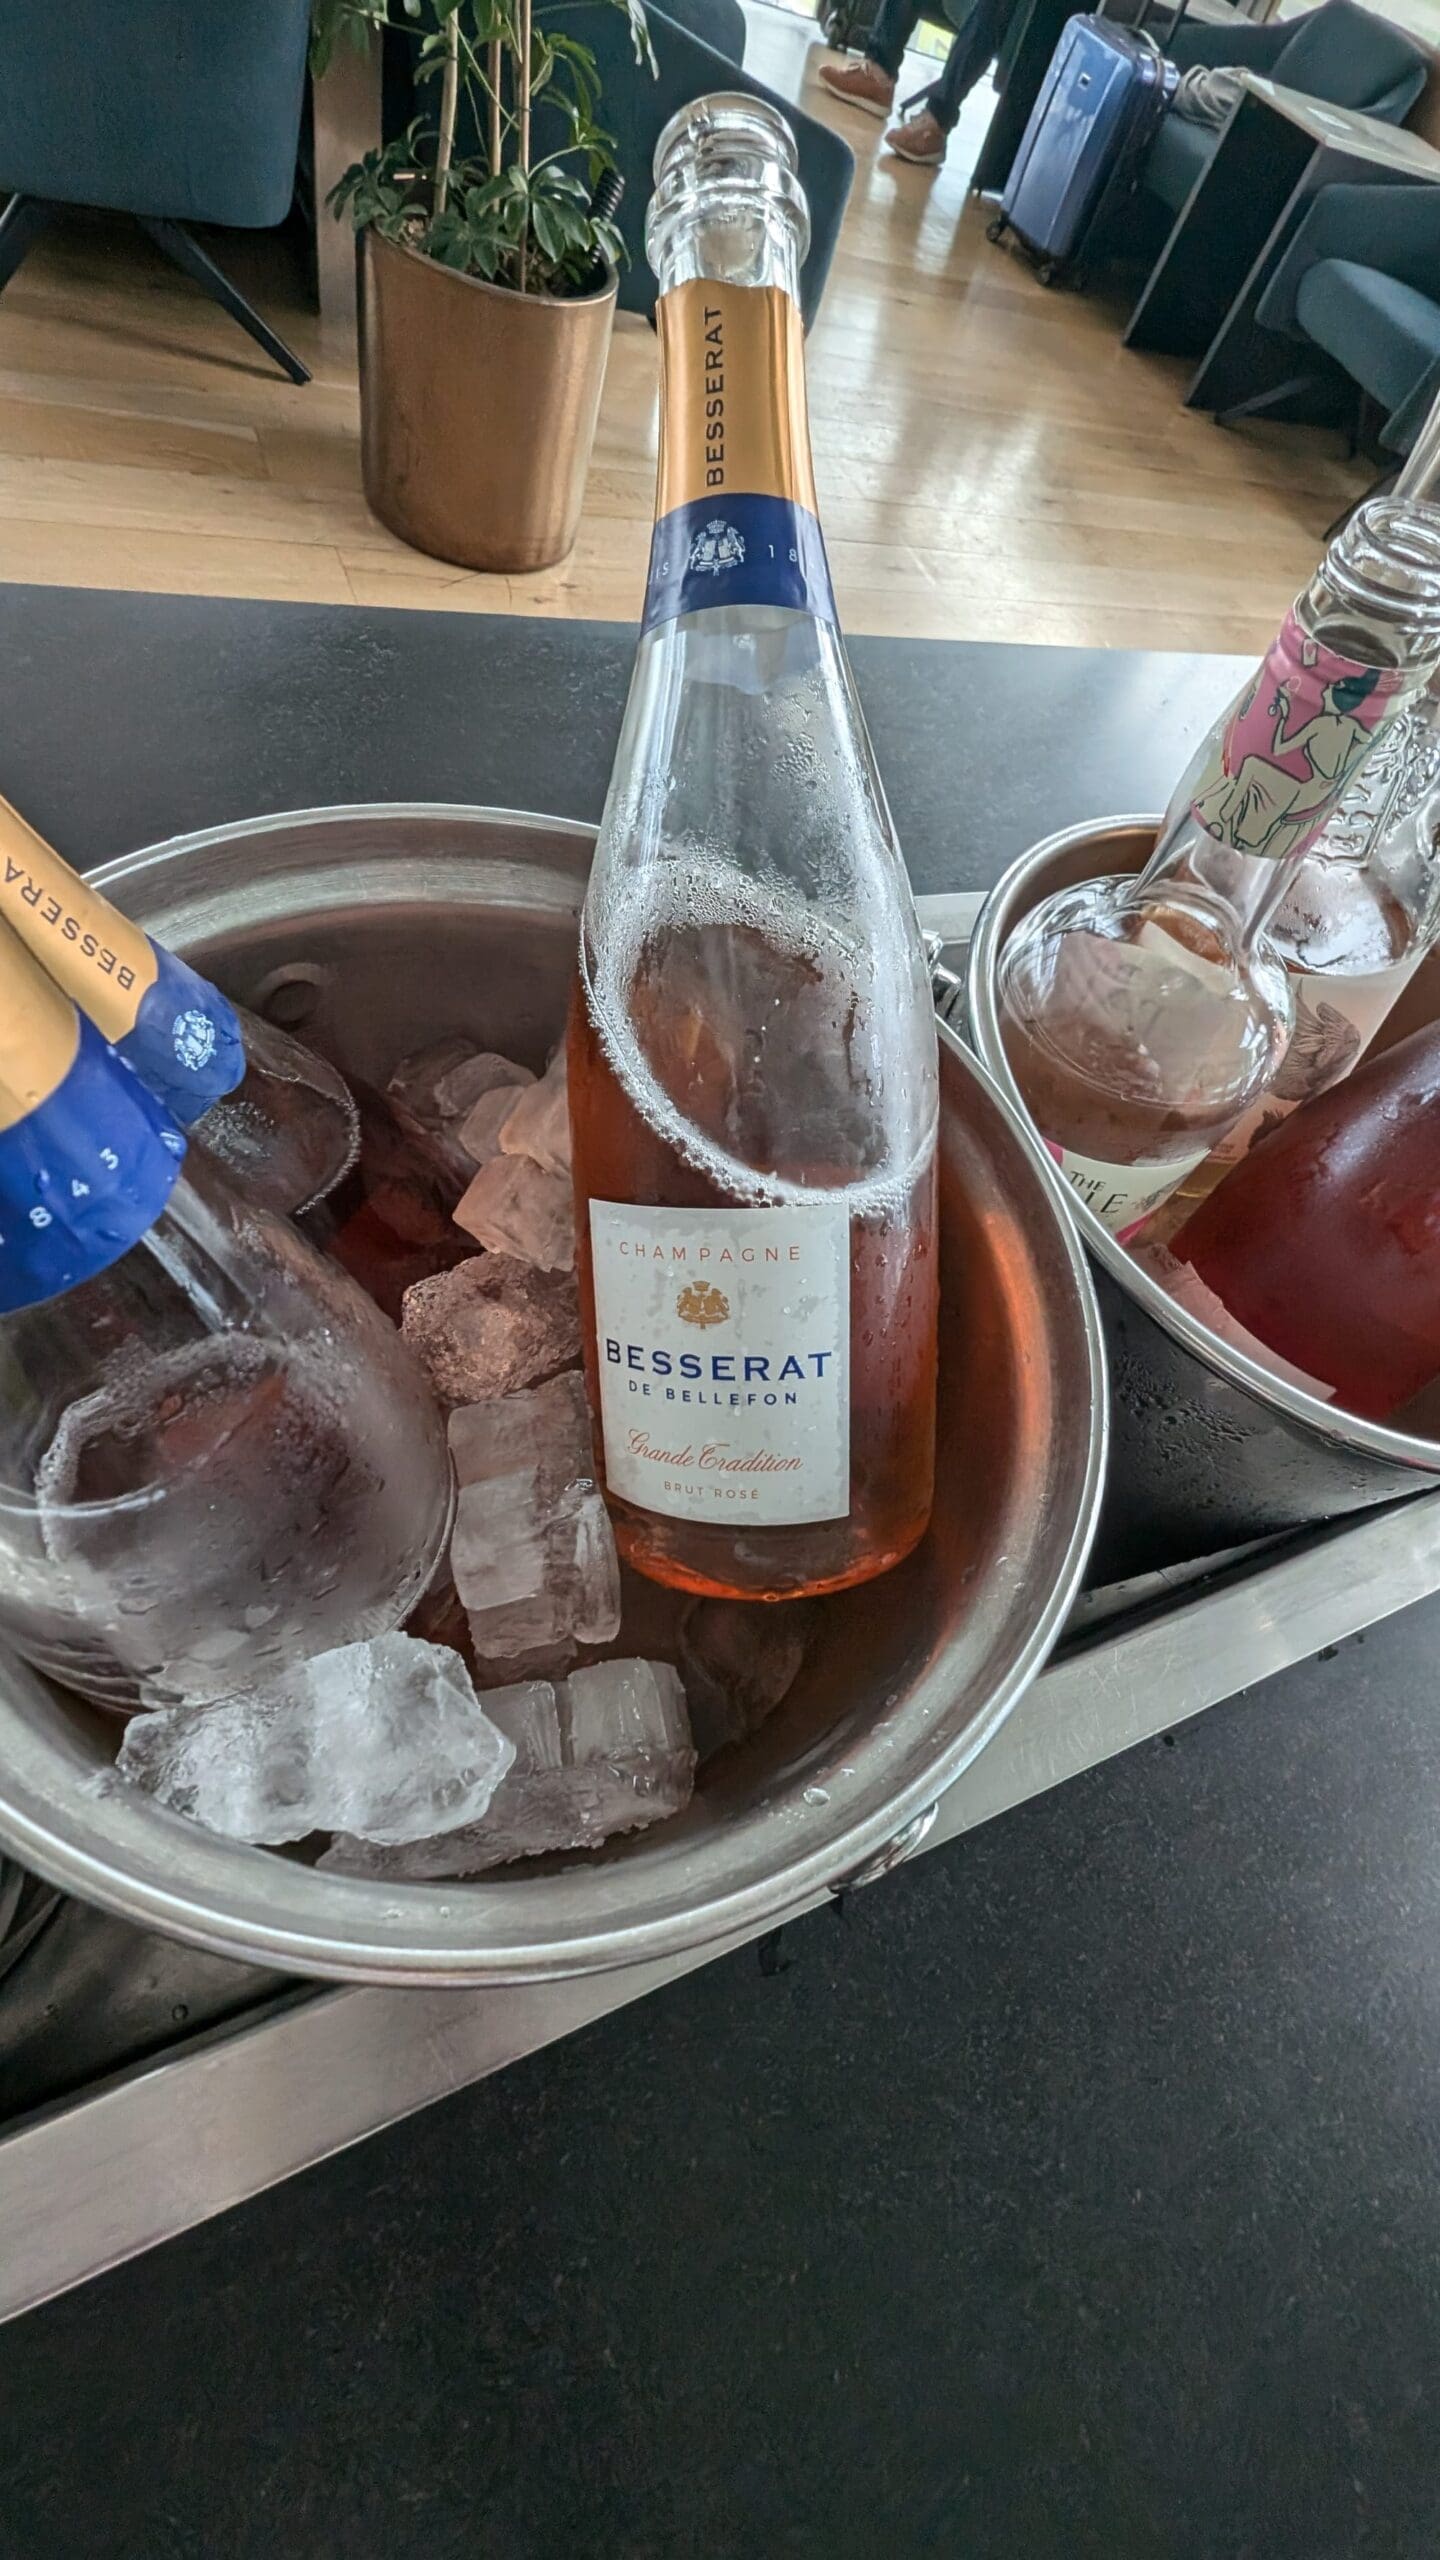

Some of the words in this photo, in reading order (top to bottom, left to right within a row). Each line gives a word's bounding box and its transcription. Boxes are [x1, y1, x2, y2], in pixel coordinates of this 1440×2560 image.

[704, 306, 724, 487] BESSERAT
[4, 856, 136, 991] BESSERA
[1071, 1171, 1106, 1191] THE
[619, 1241, 800, 1263] CHAMPAGNE
[606, 1338, 832, 1381] BESSERAT
[629, 1380, 651, 1396] DE
[666, 1388, 797, 1405] BELLEFON
[626, 1428, 694, 1467] Grande
[698, 1443, 803, 1473] Tradition
[664, 1481, 704, 1497] BRUT
[714, 1488, 760, 1500] ROSÉ
